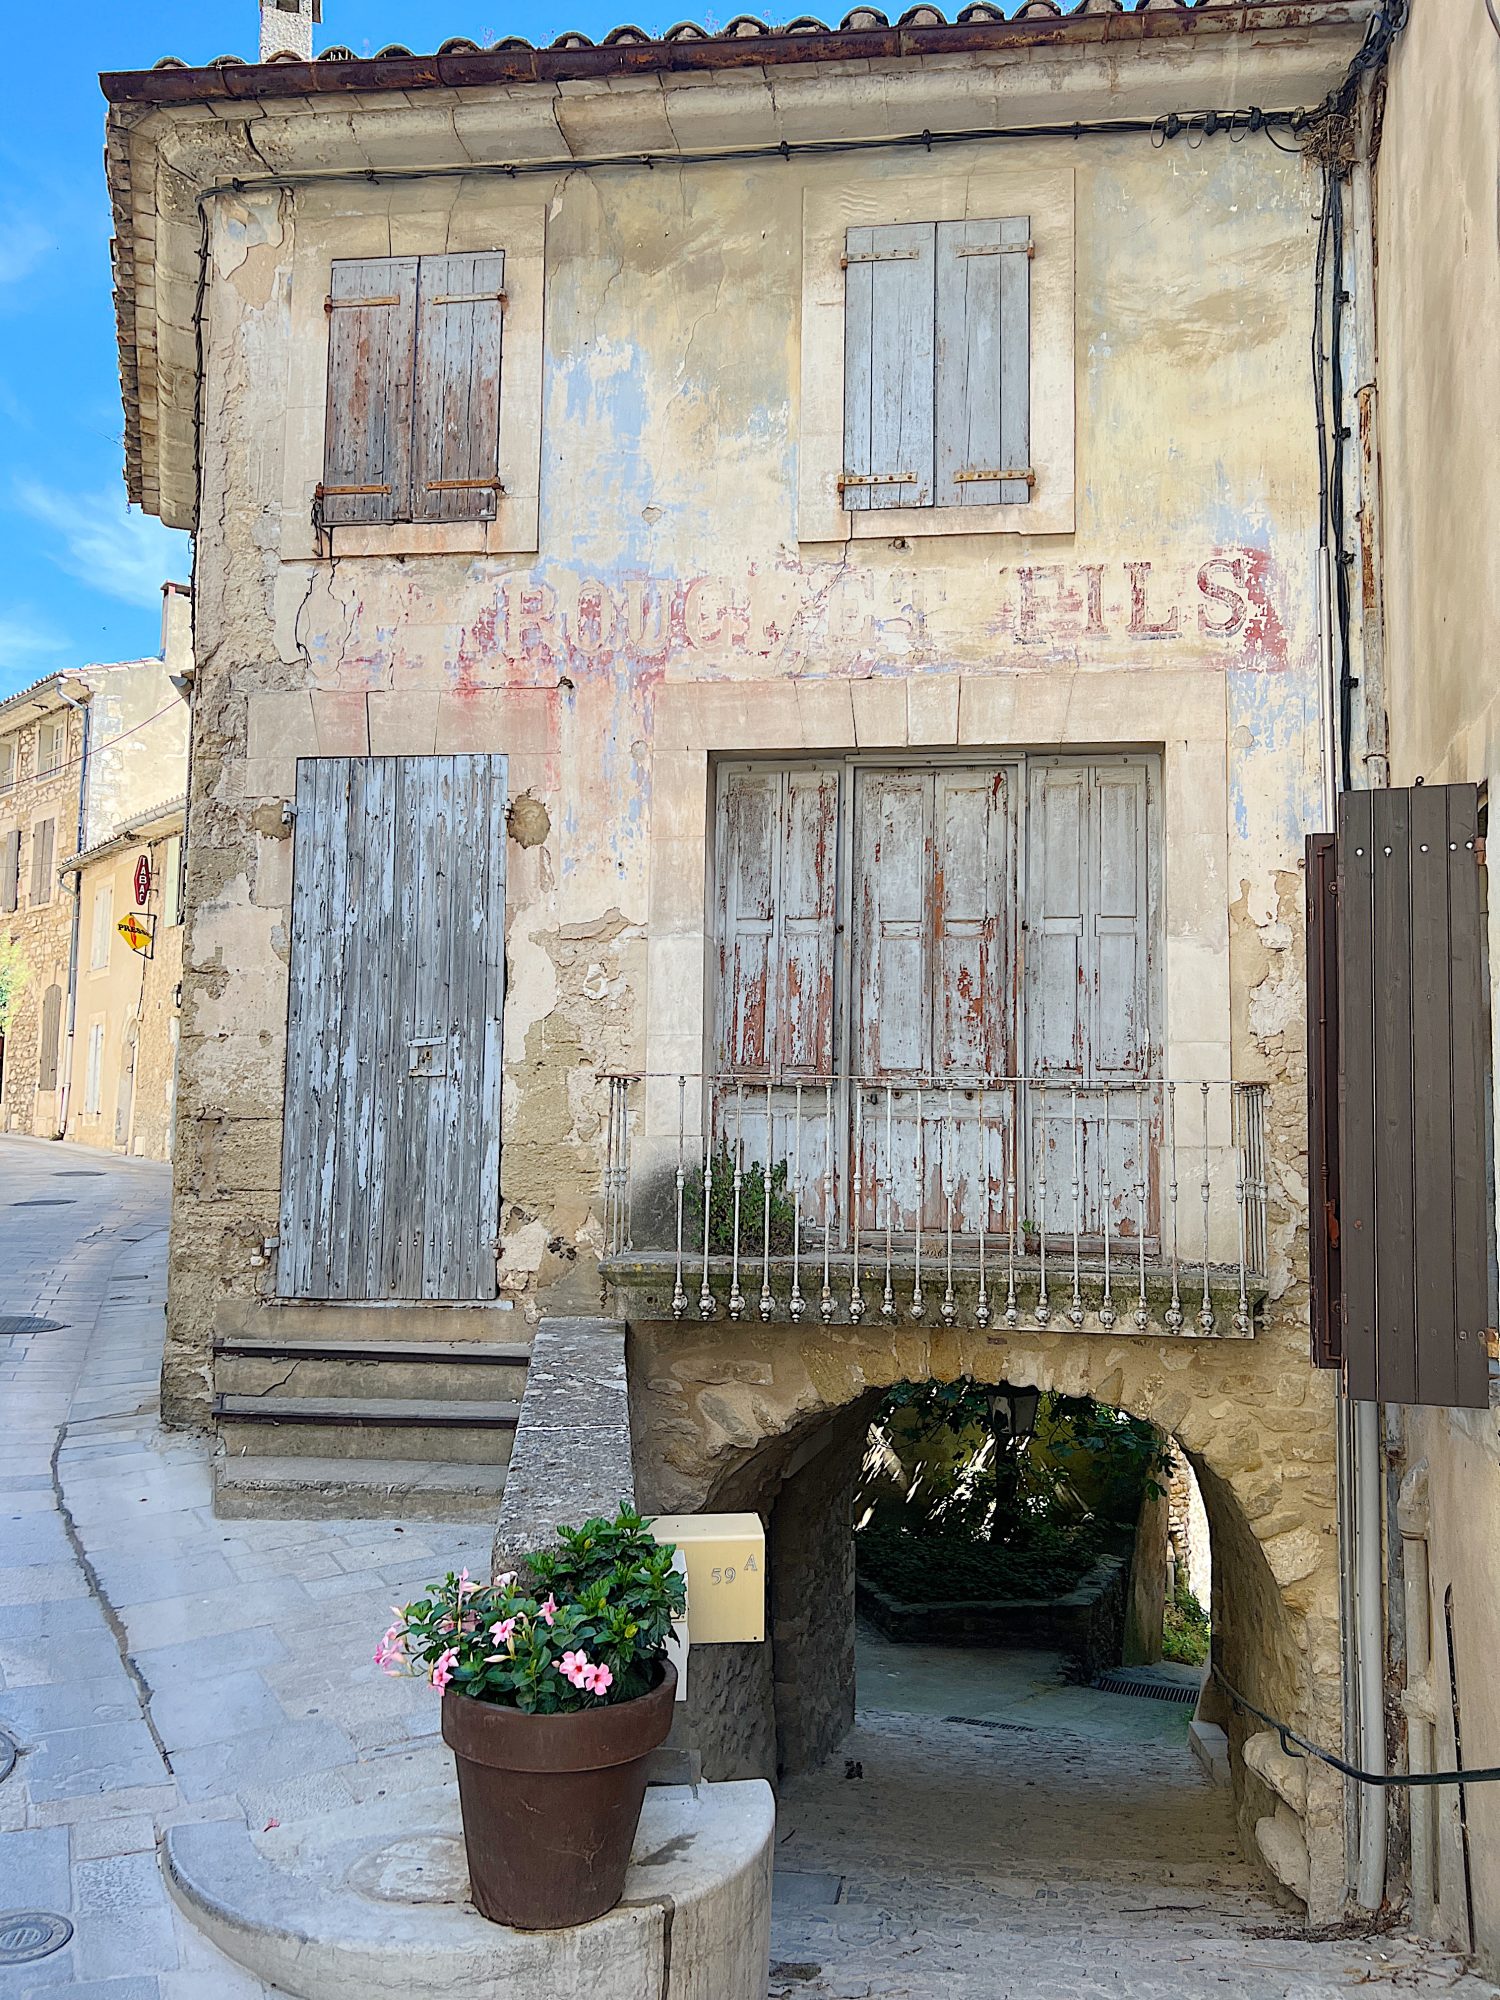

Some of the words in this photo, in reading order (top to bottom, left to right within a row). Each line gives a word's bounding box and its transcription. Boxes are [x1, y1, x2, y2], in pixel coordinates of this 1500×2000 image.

[1015, 558, 1248, 644] FILS
[139, 858, 147, 902] TABAC
[711, 1567, 737, 1586] 59
[744, 1553, 758, 1572] A
